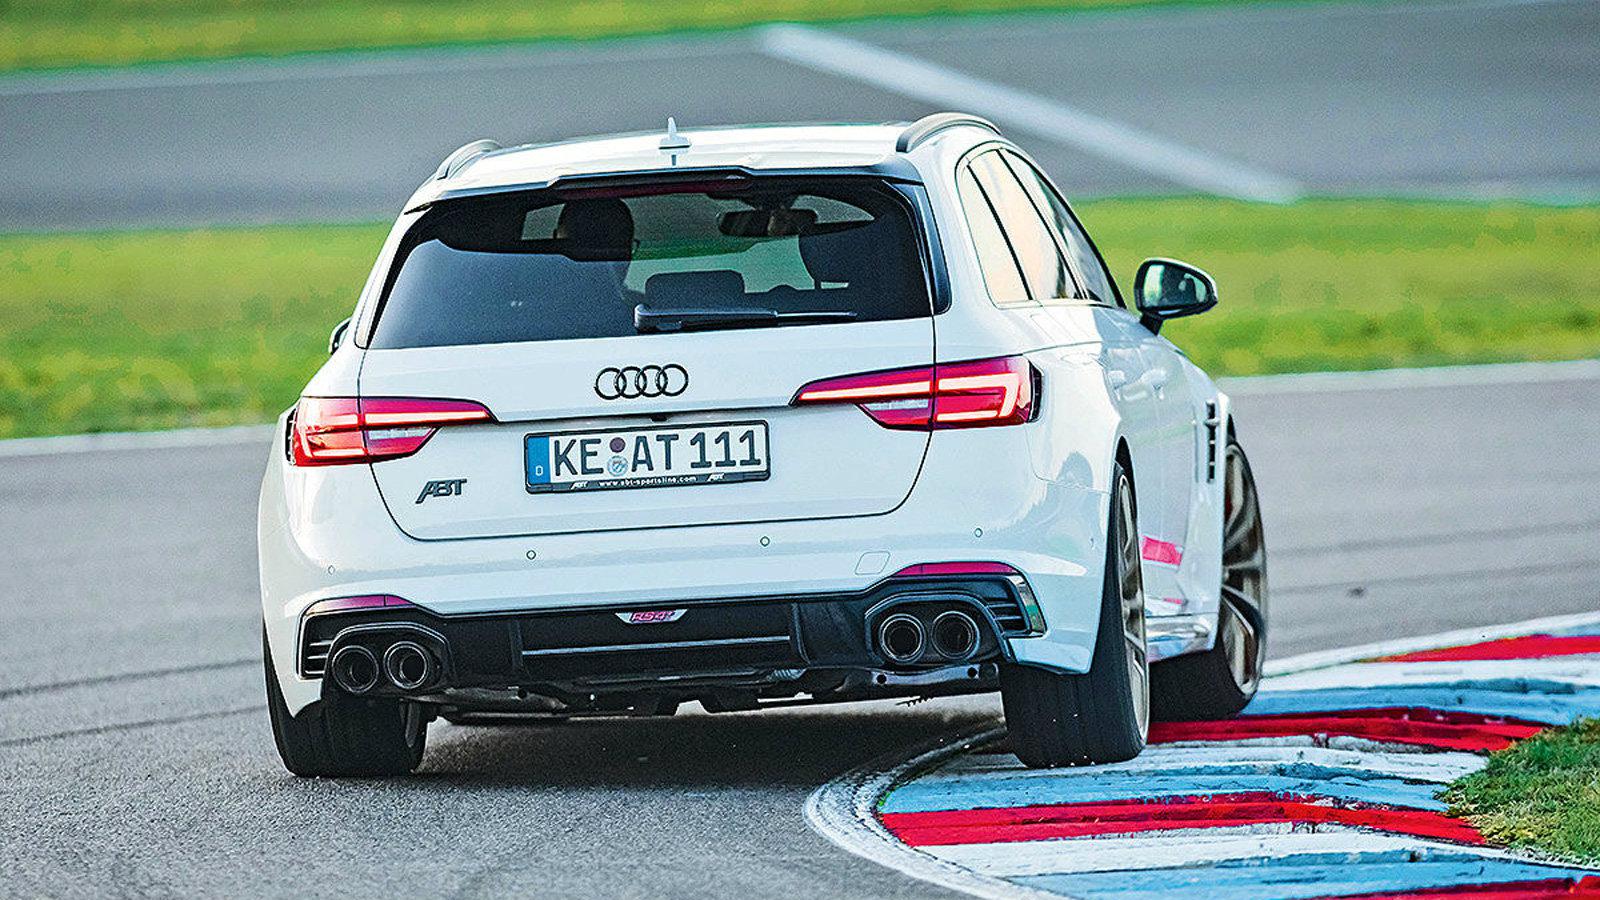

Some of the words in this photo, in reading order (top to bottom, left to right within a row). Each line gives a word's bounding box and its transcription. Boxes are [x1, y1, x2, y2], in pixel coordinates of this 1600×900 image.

[553, 437, 604, 477] KE
[631, 434, 680, 473] AT
[689, 429, 762, 469] 111
[535, 464, 544, 477] D
[415, 478, 468, 505] ABT
